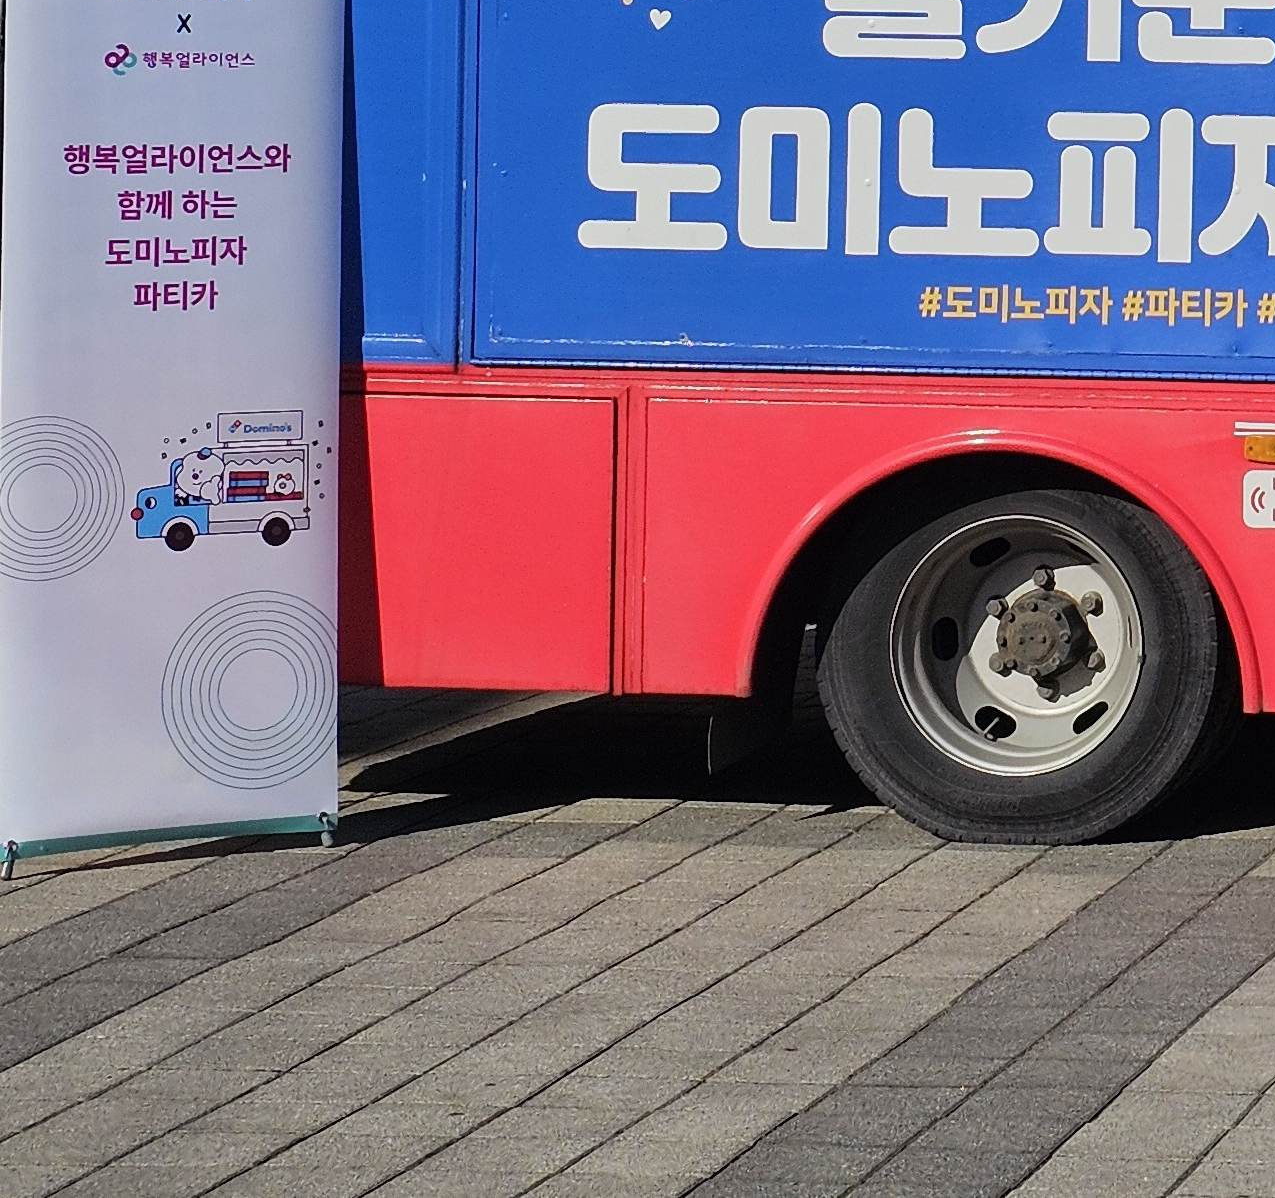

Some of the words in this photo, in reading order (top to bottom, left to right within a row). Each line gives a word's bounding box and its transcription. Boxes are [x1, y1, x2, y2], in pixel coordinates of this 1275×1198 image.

[142, 51, 256, 69] 행복얼라이언스
[63, 143, 292, 175] 행복얼라이언스와
[117, 190, 173, 220] 함께
[181, 190, 238, 219] 하는
[104, 235, 248, 268] 도미노피자
[133, 279, 219, 311] 파티카
[918, 284, 1114, 325] #도미노피자
[1121, 287, 1249, 329] #파티카
